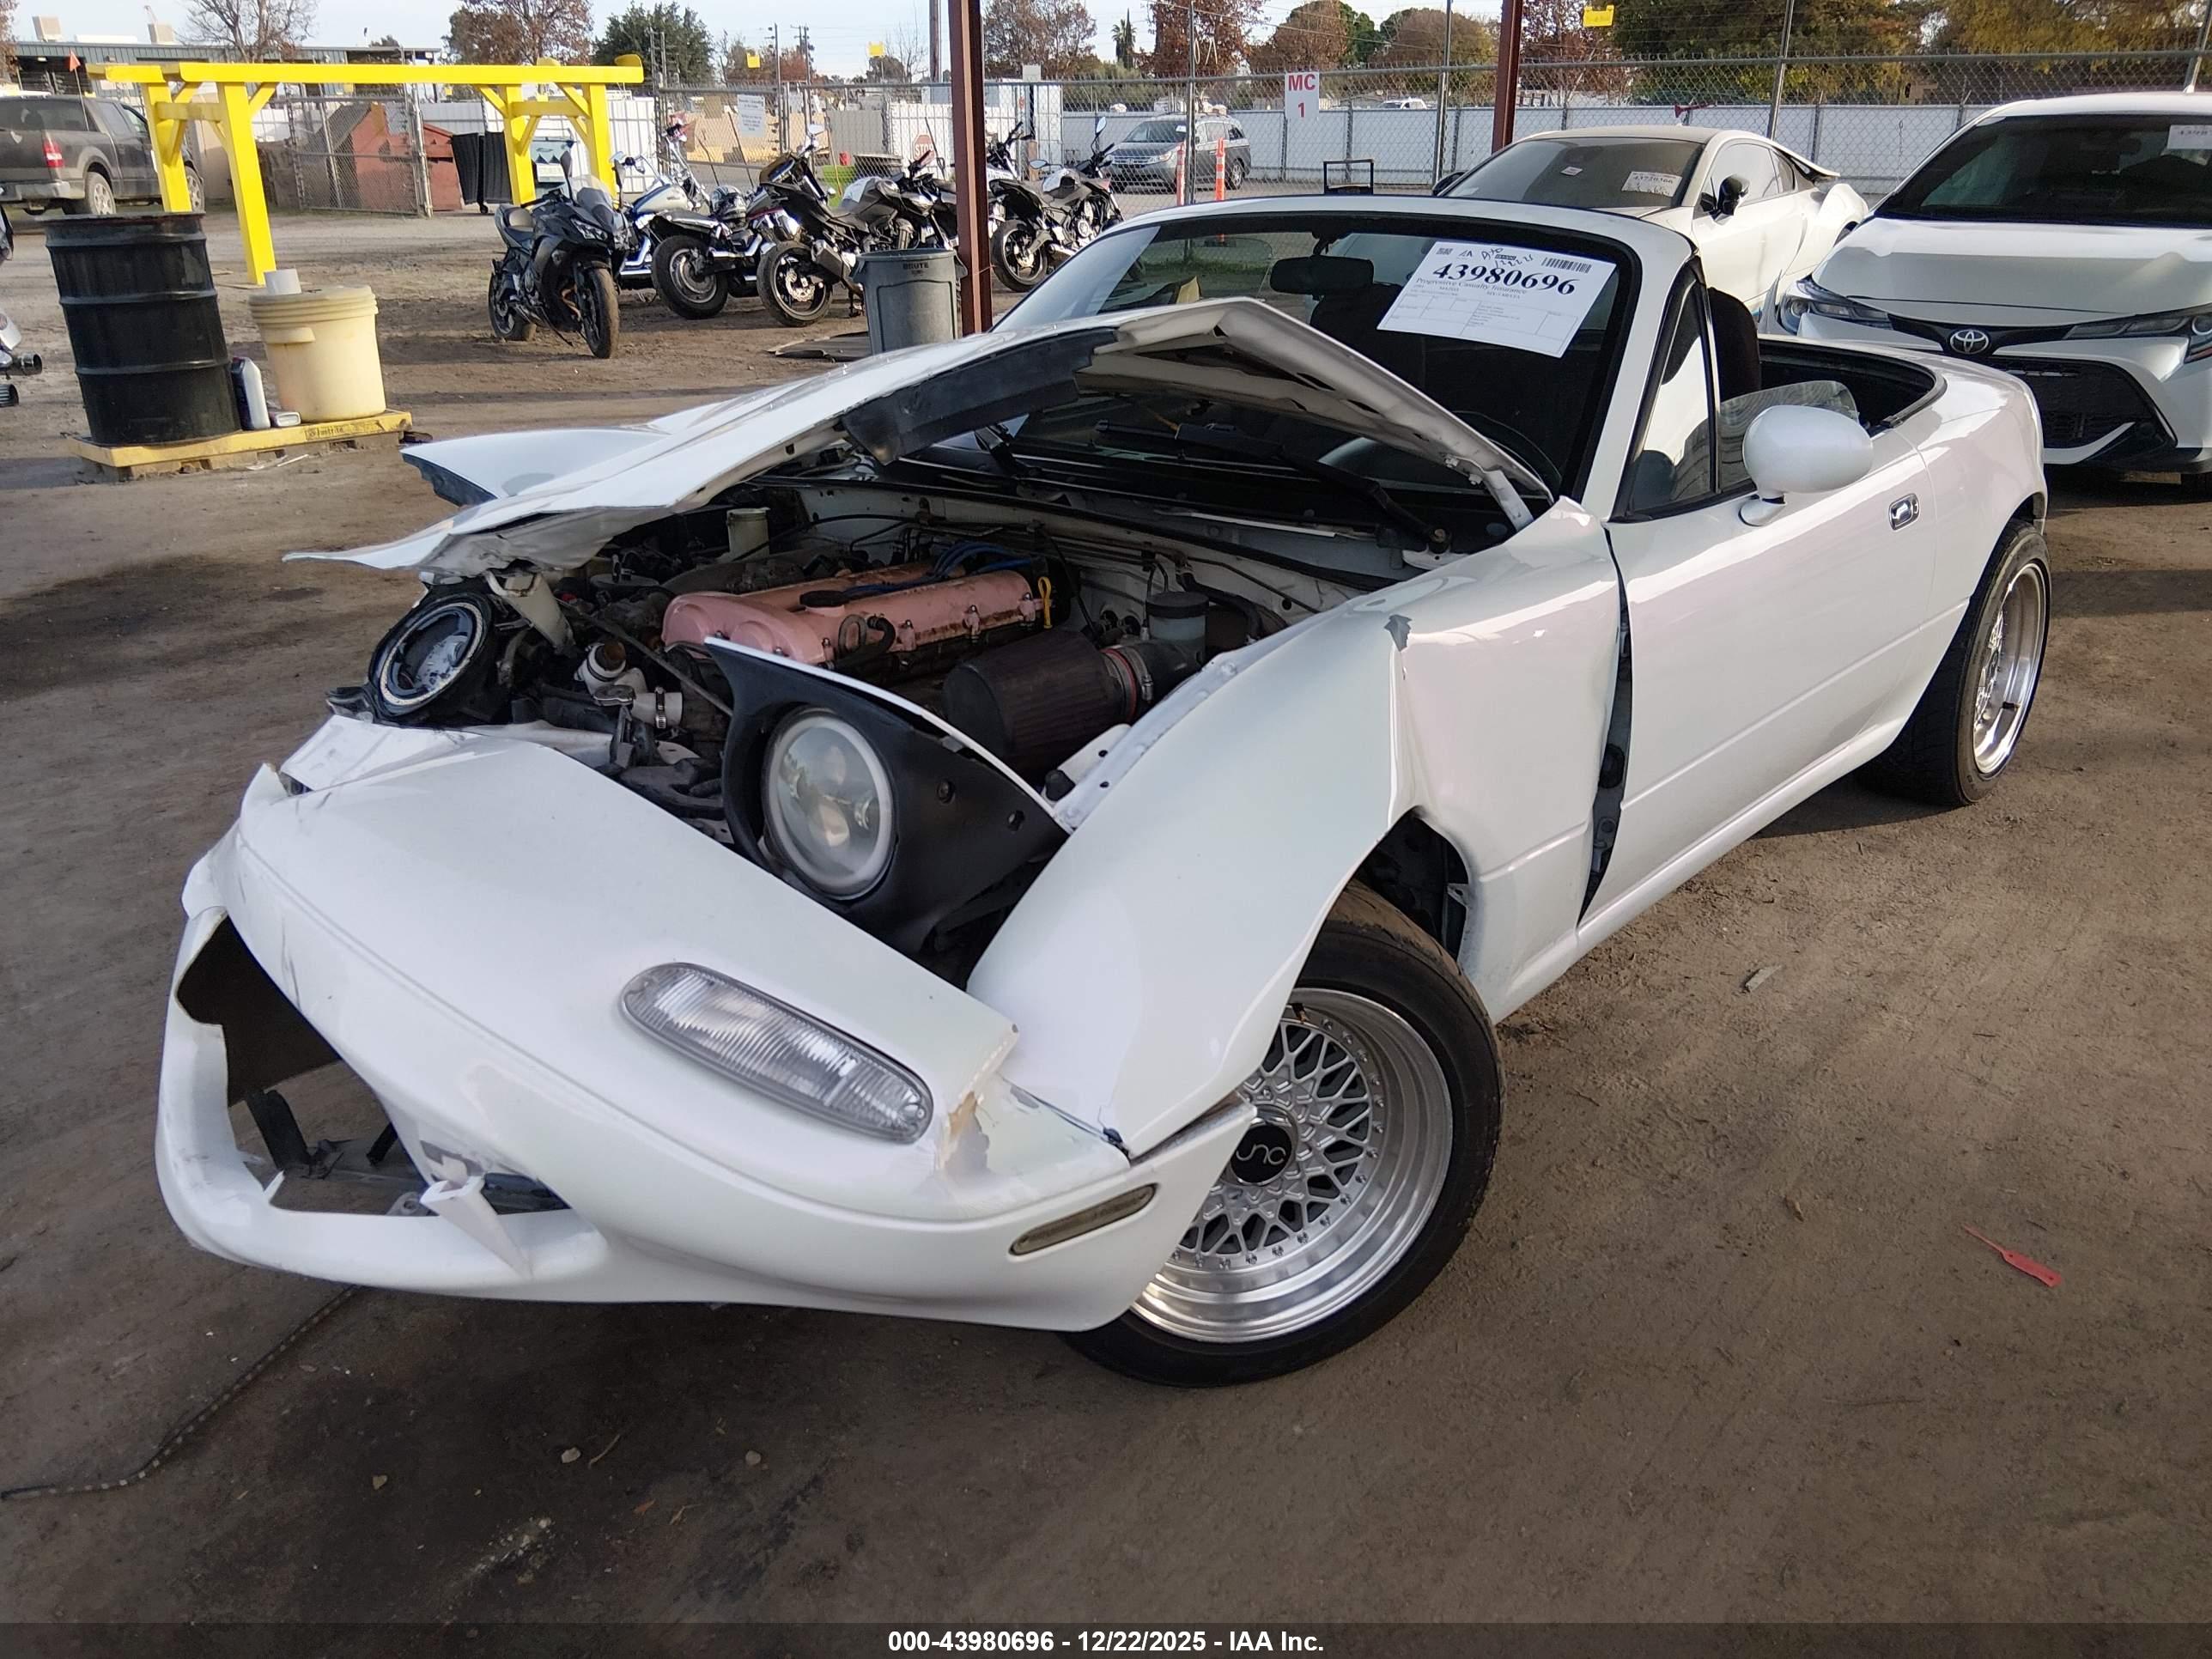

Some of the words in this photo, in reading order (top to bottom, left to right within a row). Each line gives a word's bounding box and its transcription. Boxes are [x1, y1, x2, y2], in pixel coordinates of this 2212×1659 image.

[1288, 74, 1316, 91] MC
[1298, 102, 1304, 118] 1
[915, 143, 933, 156] STOP
[902, 261, 929, 270] BRUTE
[1433, 262, 1580, 295] 43980696
[1459, 281, 1489, 290] Casualty
[1491, 284, 1527, 295] Insurance
